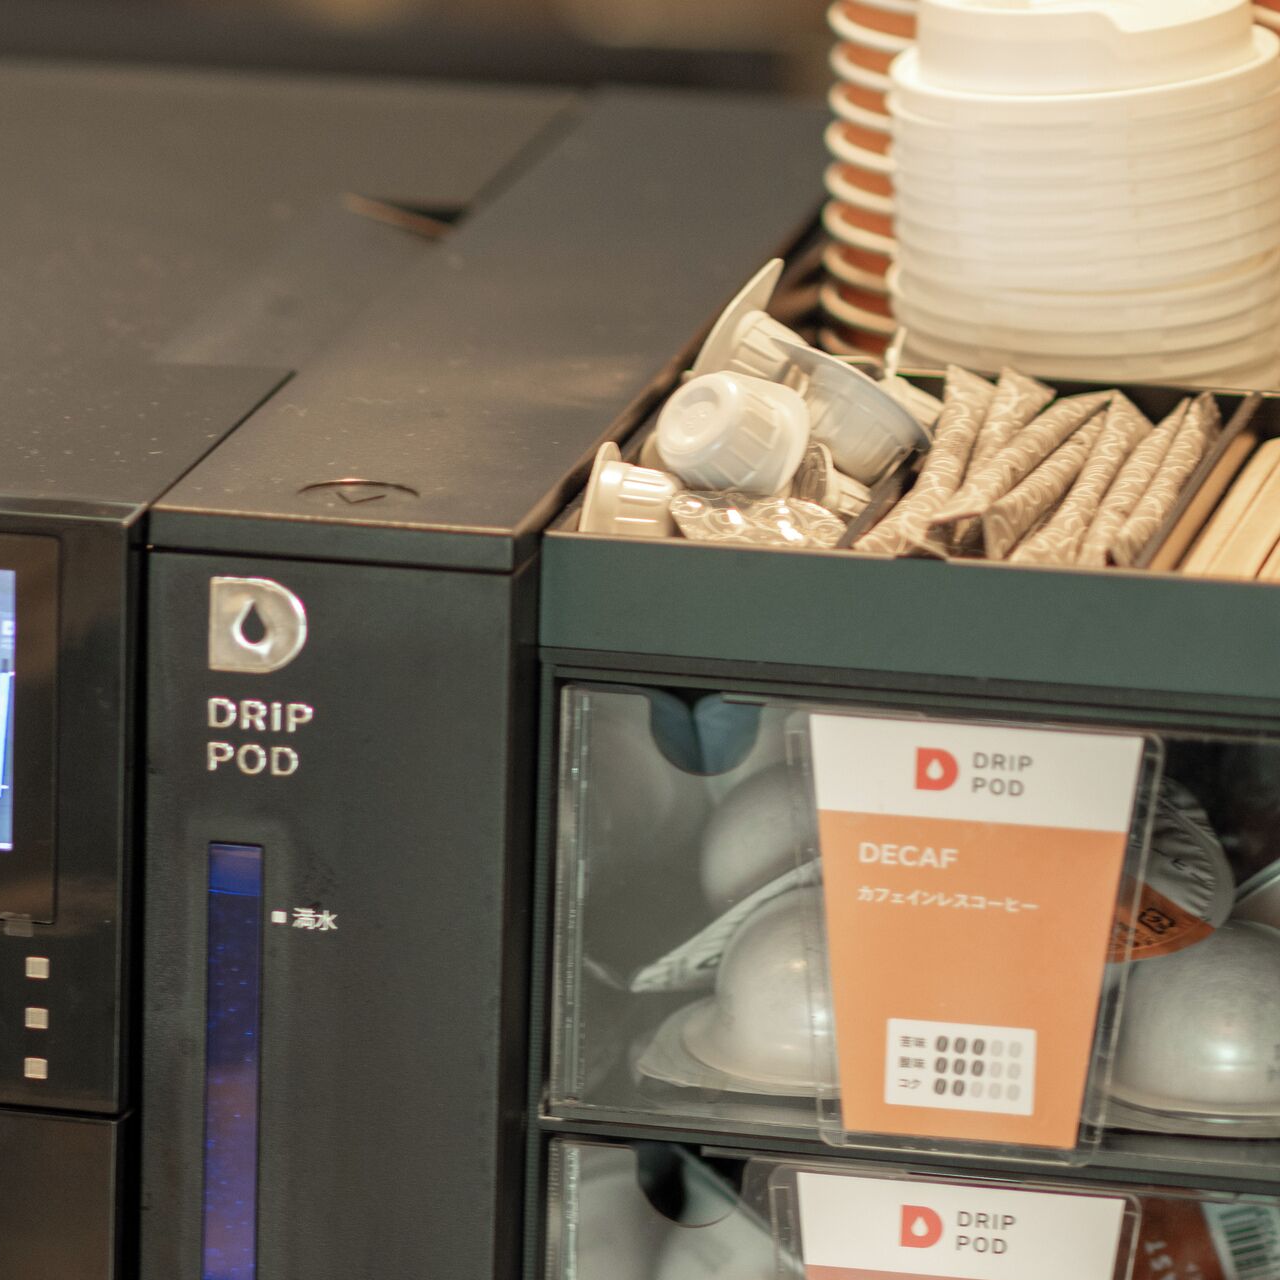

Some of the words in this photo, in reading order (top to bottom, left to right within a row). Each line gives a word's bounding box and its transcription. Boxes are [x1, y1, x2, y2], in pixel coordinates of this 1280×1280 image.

[207, 697, 314, 732] DRIP
[207, 742, 299, 776] POD
[972, 752, 1034, 772] DRIP
[971, 777, 1025, 797] POD
[858, 842, 959, 869] DECAF
[858, 886, 1040, 912] カフェインレスコーヒー
[956, 1211, 1017, 1231] DRIP
[955, 1235, 1008, 1255] POD
